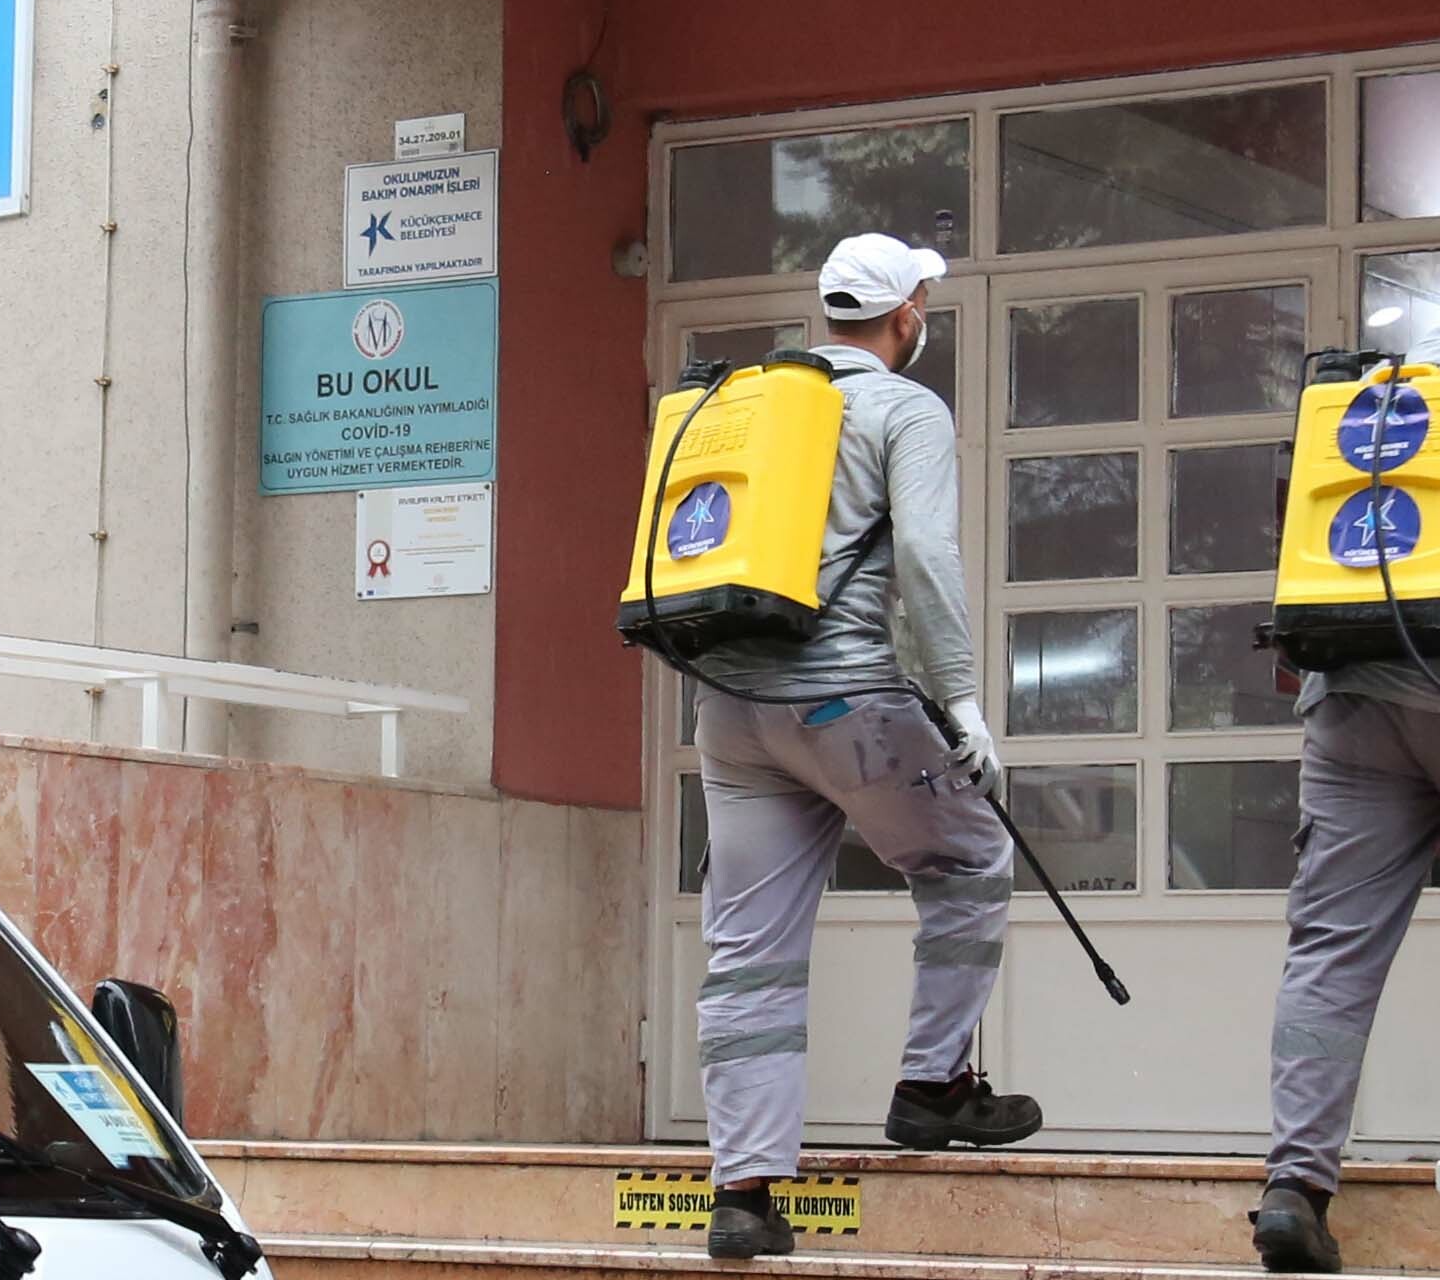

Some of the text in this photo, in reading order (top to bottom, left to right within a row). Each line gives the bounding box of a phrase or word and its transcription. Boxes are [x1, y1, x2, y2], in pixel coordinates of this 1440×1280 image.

[383, 166, 460, 186] OKULUMUZUN
[361, 177, 480, 202] BAKIM ONARIM İŞLERİ
[400, 210, 483, 229] KÜÇÜKÇEKMECE
[400, 224, 456, 241] BELEDİYESİ
[358, 257, 483, 277] TARAFINDAN YAPILMAKTADIR
[317, 366, 439, 399] BU OKUL
[266, 397, 489, 426] T.C. SAĞLIK BAKANLIĞININ YAYIMLADIĞI
[341, 423, 411, 442] COVİD-19
[263, 450, 304, 466] SALGIN
[306, 444, 355, 463] YÖNETİMİ
[357, 446, 371, 459] VE
[374, 443, 422, 460] ÇALIŞMA
[287, 465, 328, 480] UYGUN
[331, 462, 374, 477] HİZMET
[620, 1187, 664, 1211] LÜTFEN
[794, 1196, 855, 1217] KORUYUN!
